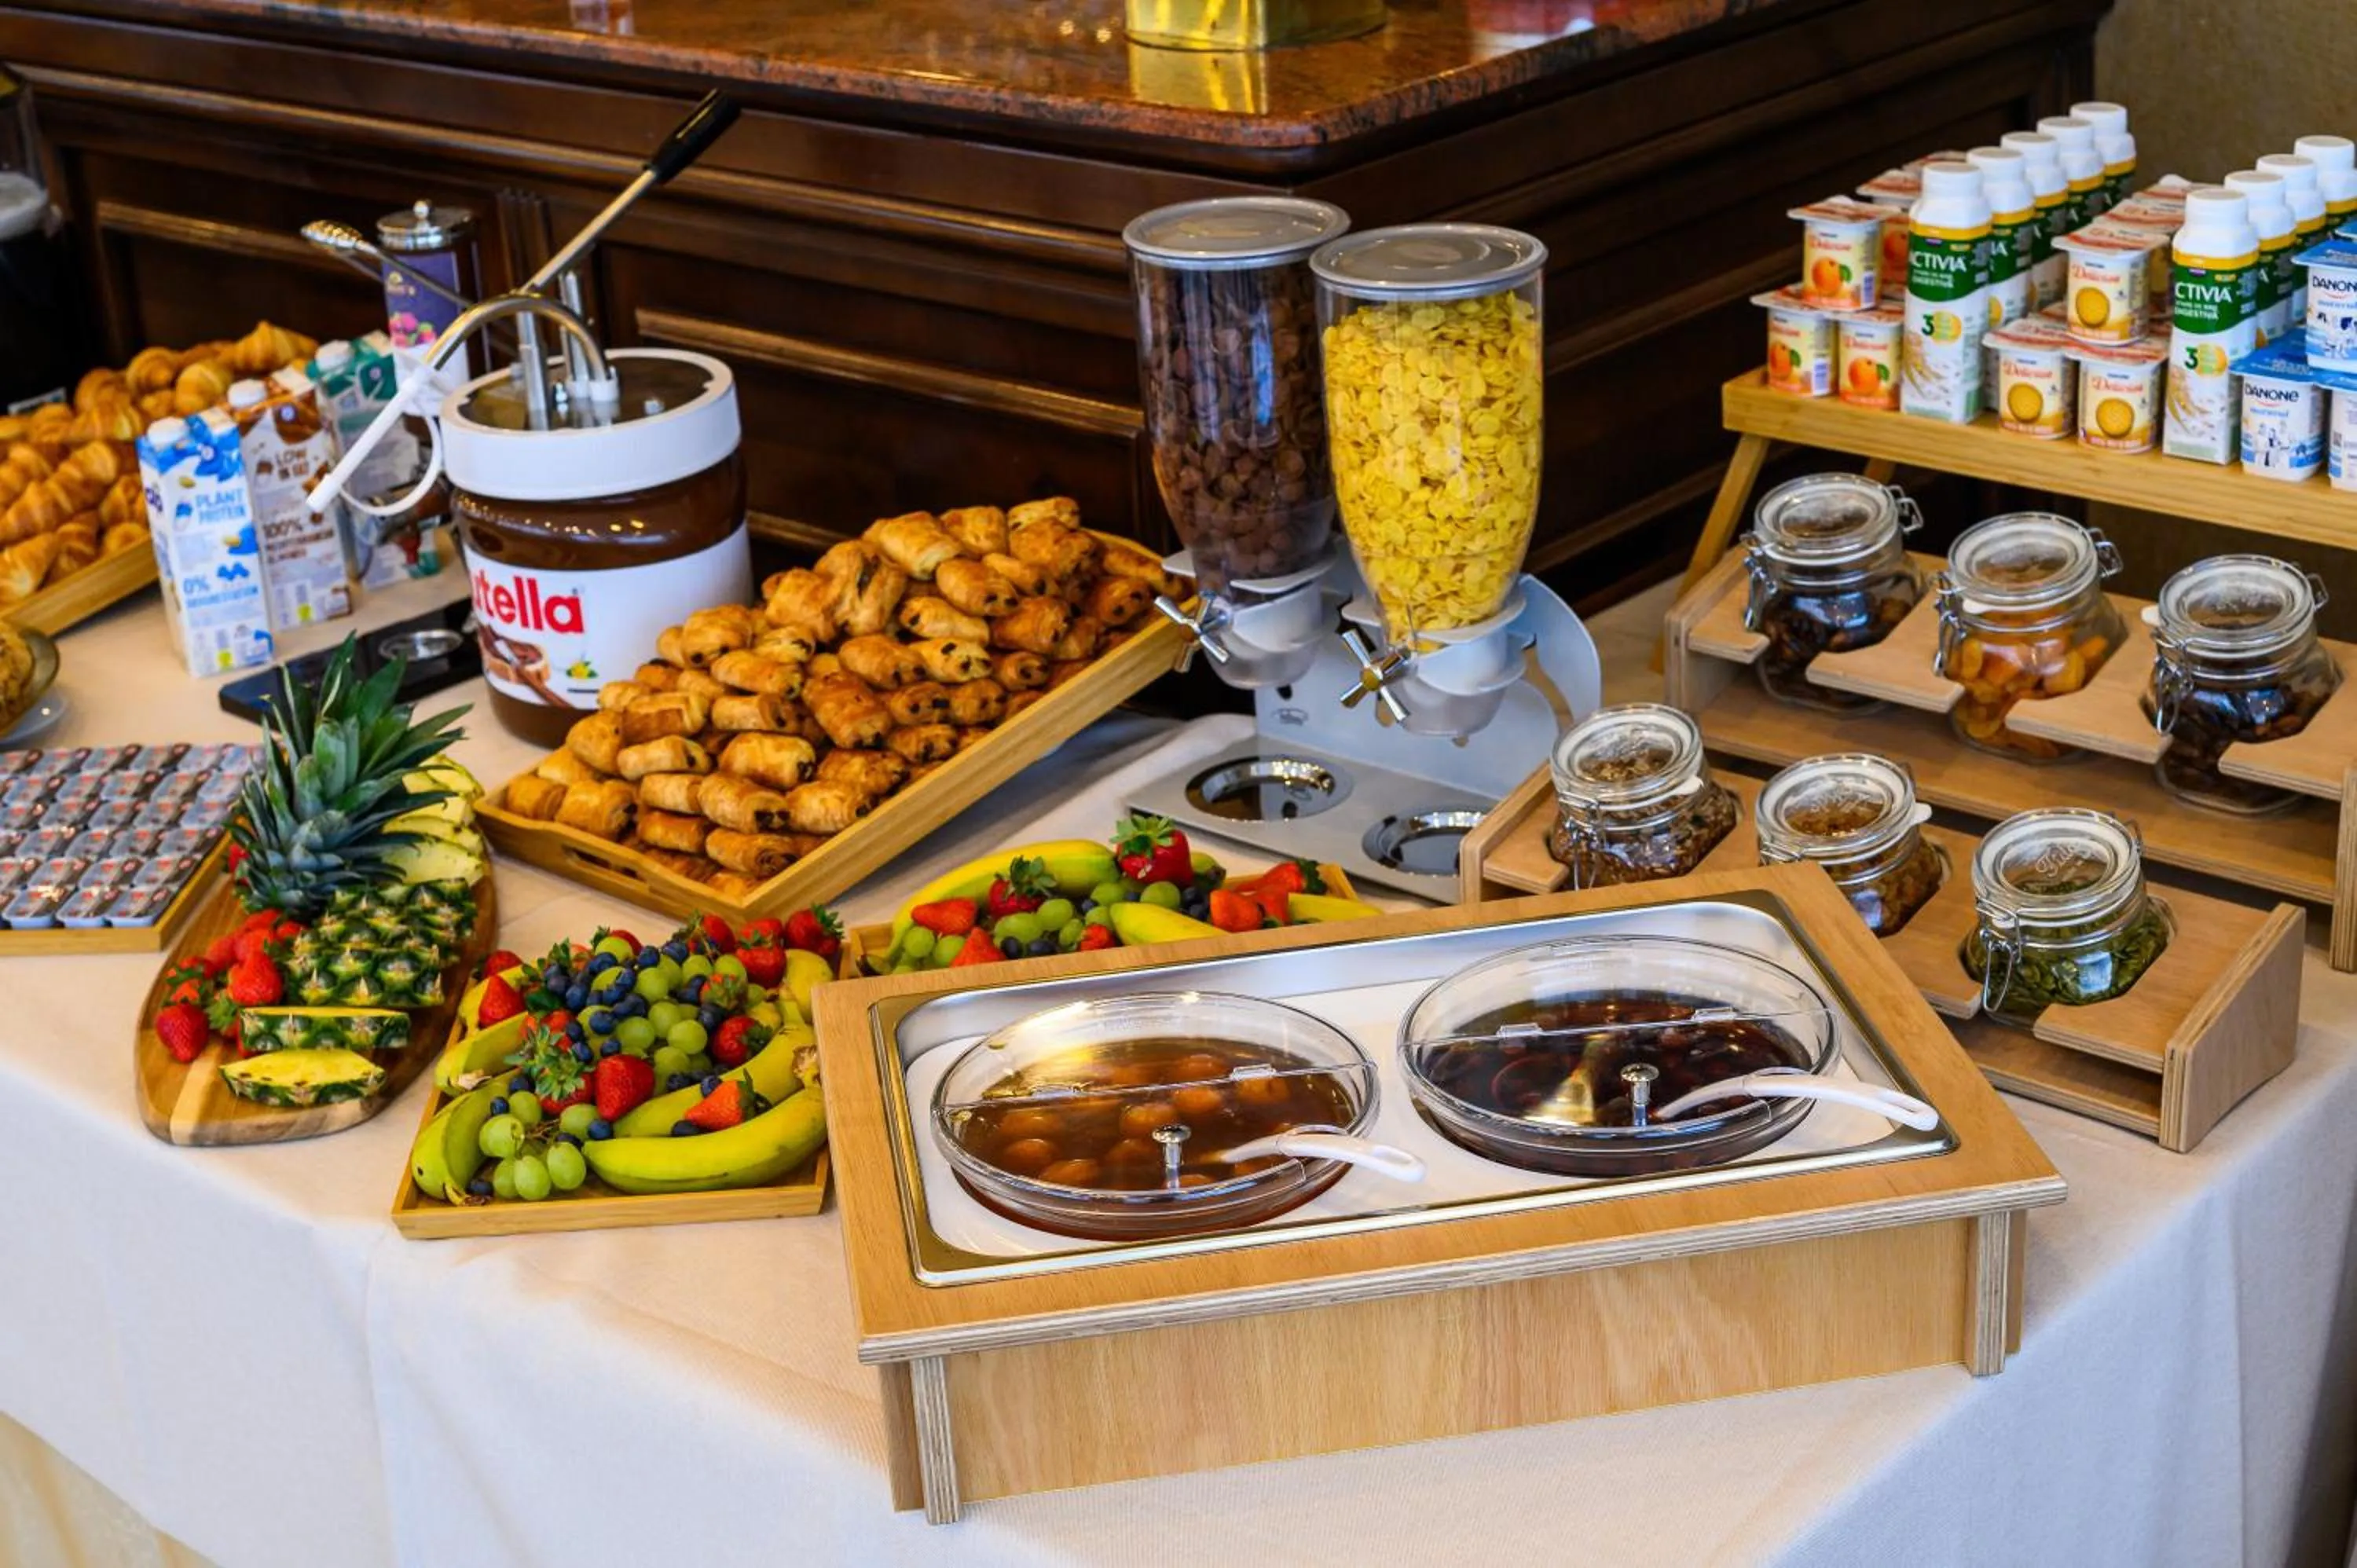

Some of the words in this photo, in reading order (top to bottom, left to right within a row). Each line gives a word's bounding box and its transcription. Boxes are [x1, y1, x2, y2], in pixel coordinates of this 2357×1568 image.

[1908, 251, 1967, 273] CTIVIA
[2174, 282, 2233, 303] CTIVIA
[2312, 276, 2357, 292] DANON
[1921, 314, 1935, 335] 3
[2184, 346, 2198, 370] 3
[196, 489, 244, 507] PLANT
[183, 577, 210, 594] 0%
[473, 569, 584, 634] tella
